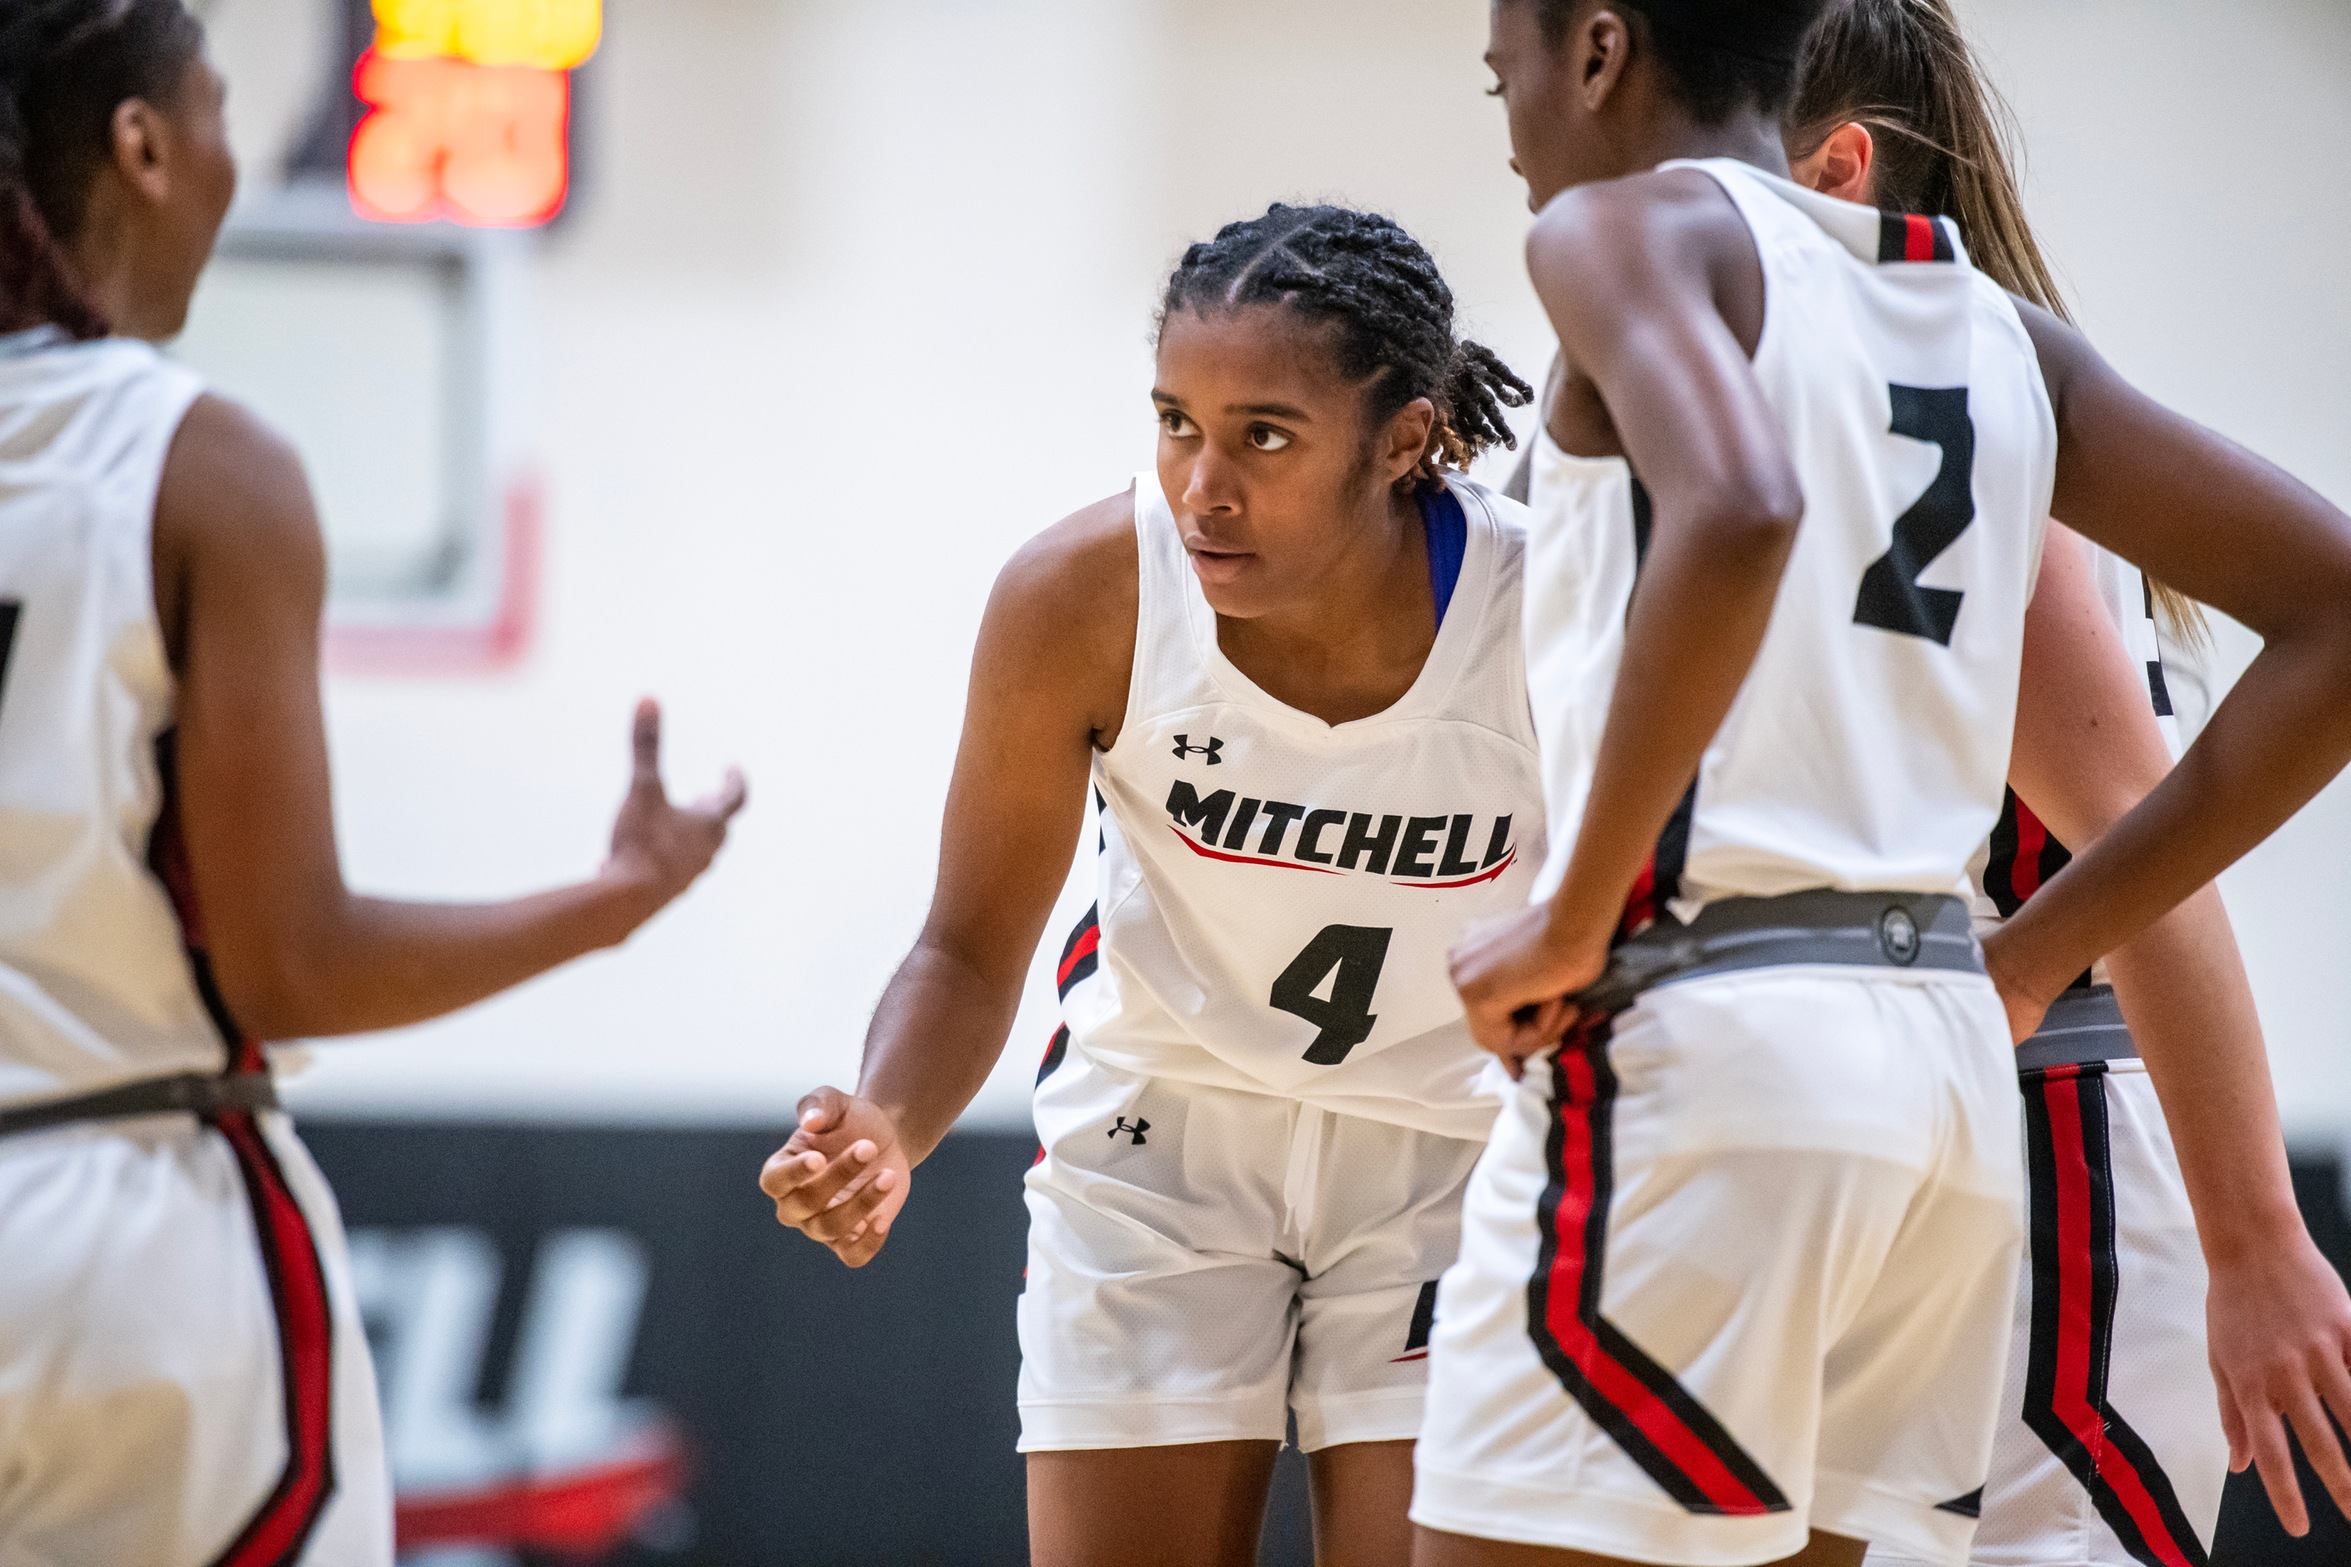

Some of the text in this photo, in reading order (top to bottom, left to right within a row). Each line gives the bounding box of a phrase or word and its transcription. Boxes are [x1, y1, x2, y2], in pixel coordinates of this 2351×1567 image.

[1853, 382, 1975, 647] 2
[1165, 779, 1516, 878] MITCHELL
[1269, 923, 1393, 1065] 4
